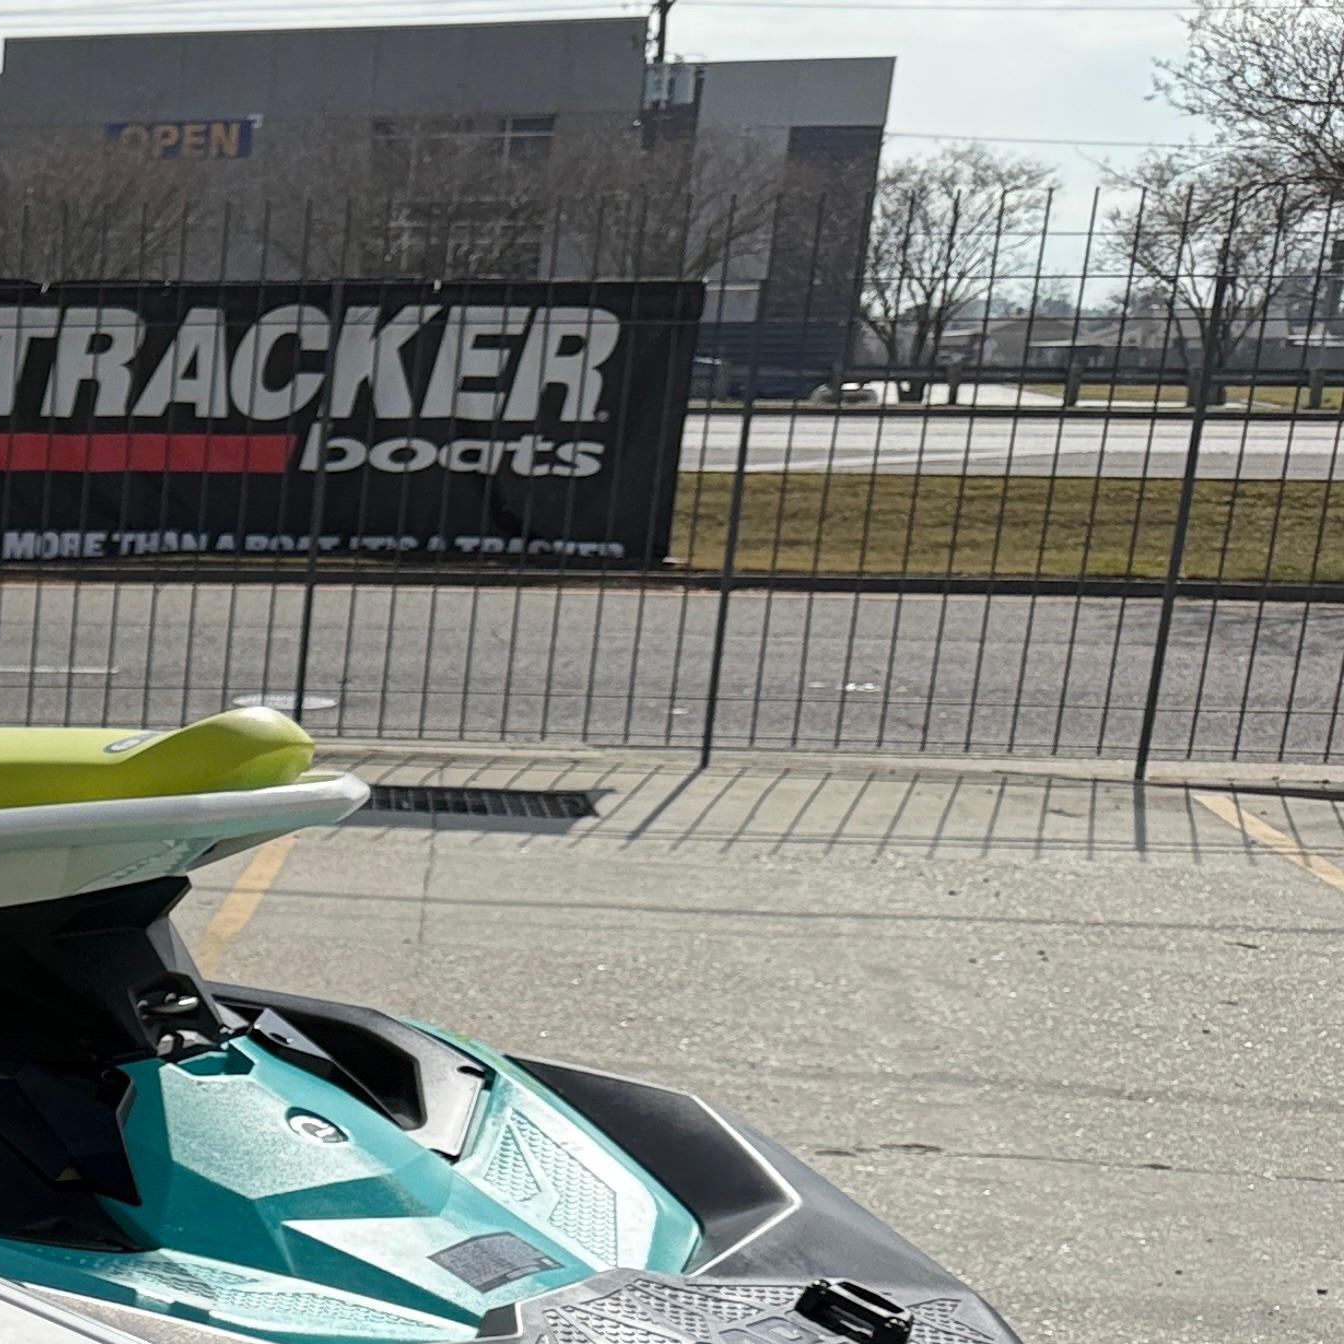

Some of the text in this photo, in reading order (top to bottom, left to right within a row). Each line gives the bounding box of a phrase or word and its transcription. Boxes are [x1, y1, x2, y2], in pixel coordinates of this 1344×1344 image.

[119, 121, 241, 159] OPEN
[300, 422, 605, 478] boats
[2, 531, 108, 560] MORE
[112, 532, 209, 556] THAN
